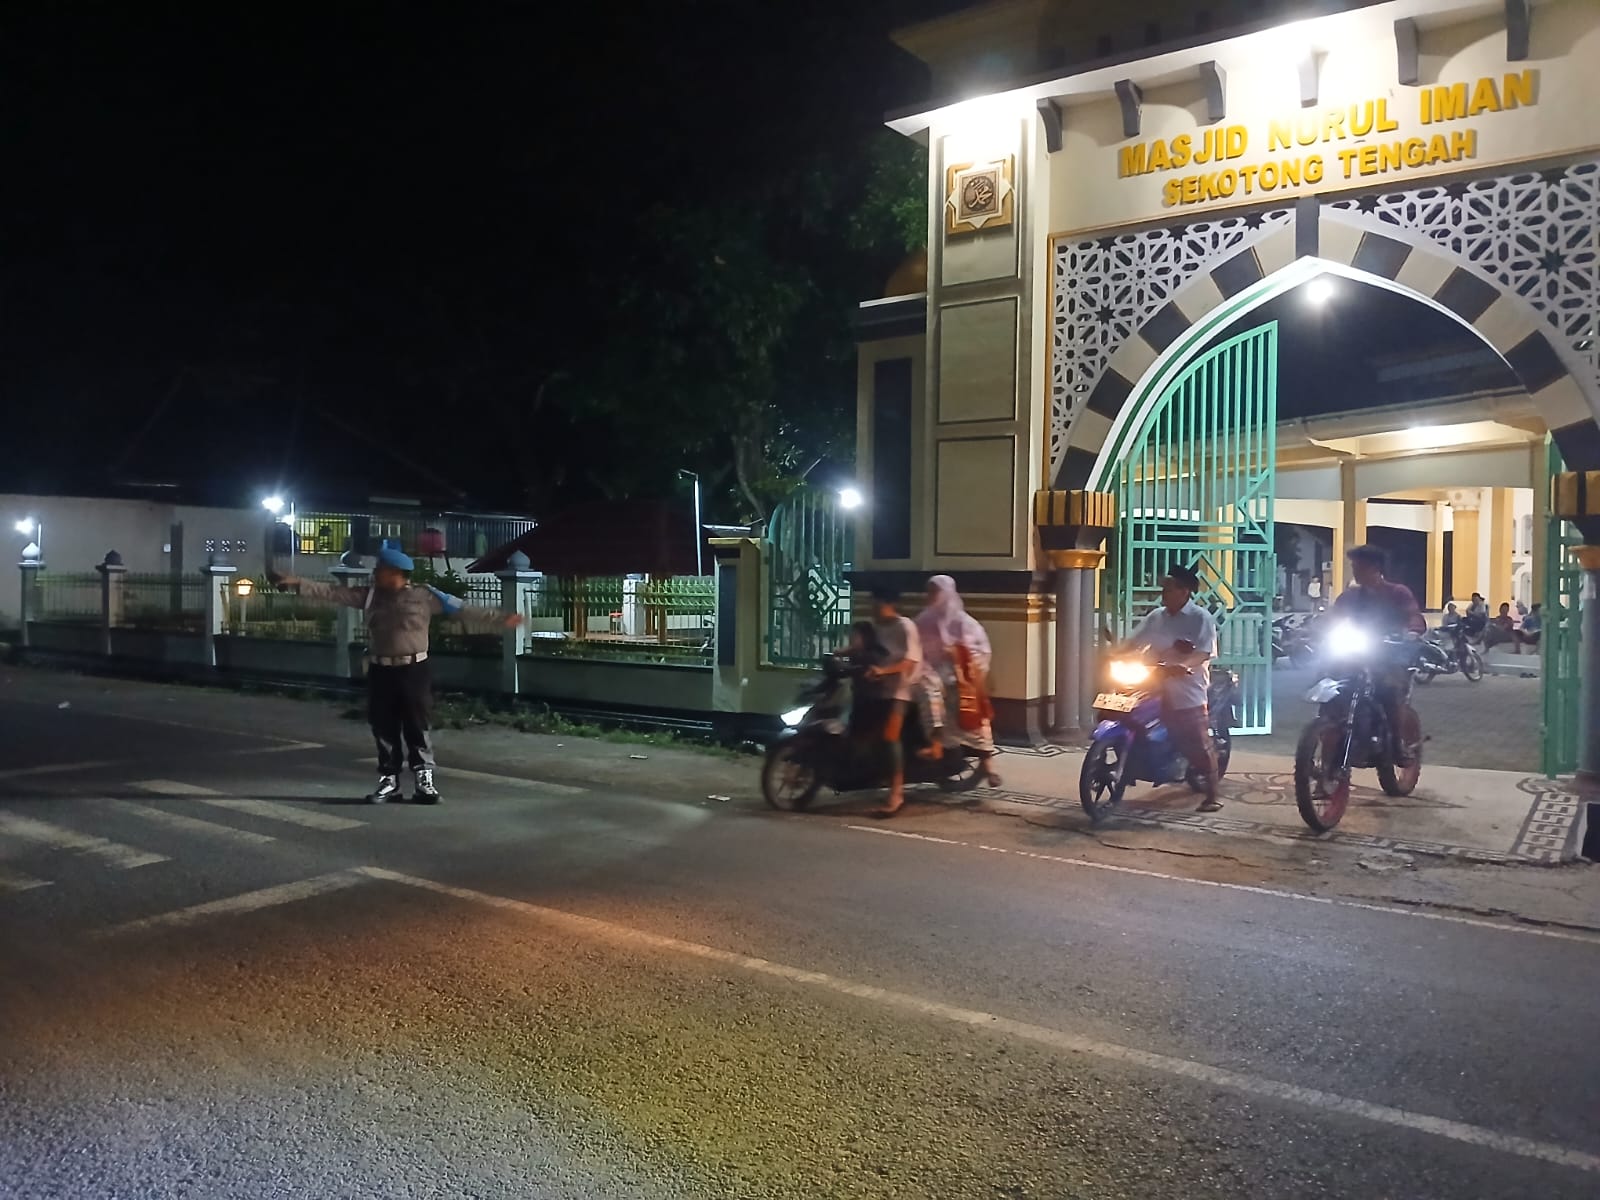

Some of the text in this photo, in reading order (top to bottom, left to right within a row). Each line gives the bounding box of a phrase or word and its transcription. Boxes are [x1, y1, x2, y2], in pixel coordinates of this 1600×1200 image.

[1119, 69, 1534, 178] MASJID NURUL IMAN
[1163, 129, 1477, 206] SEKOTONG TENGAH
